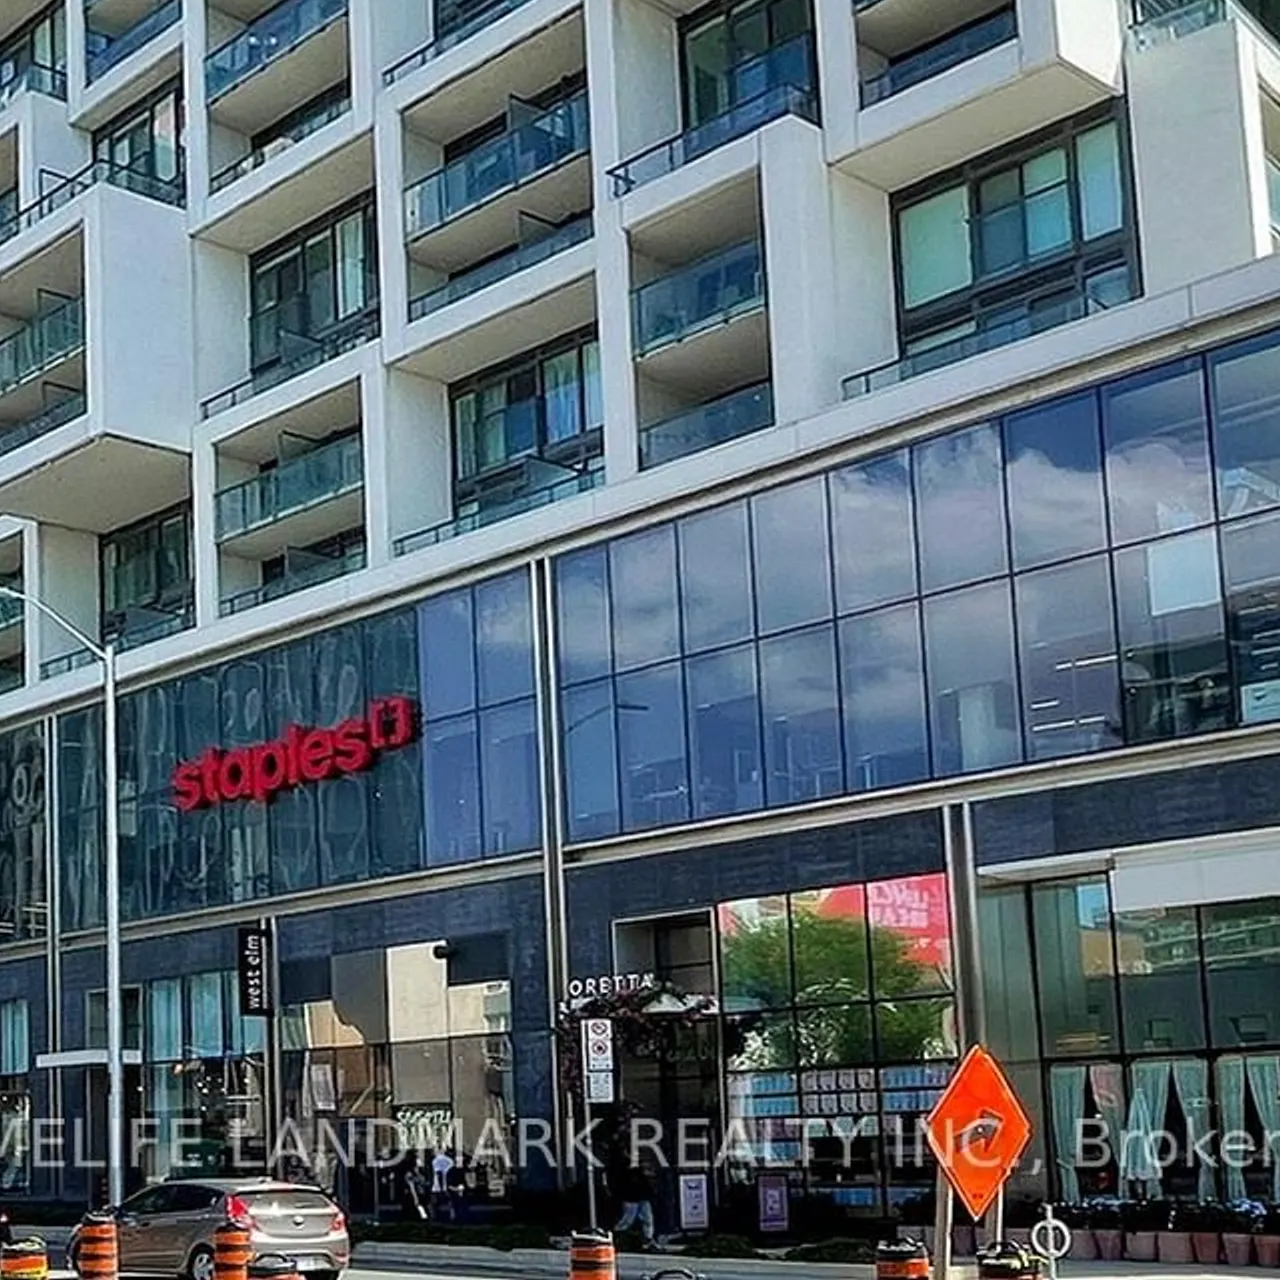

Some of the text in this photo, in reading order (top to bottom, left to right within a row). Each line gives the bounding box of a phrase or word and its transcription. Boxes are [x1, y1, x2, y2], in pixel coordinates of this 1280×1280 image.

[174, 719, 369, 810] staples
[244, 935, 261, 1010] west elm
[569, 973, 655, 996] ORETTA
